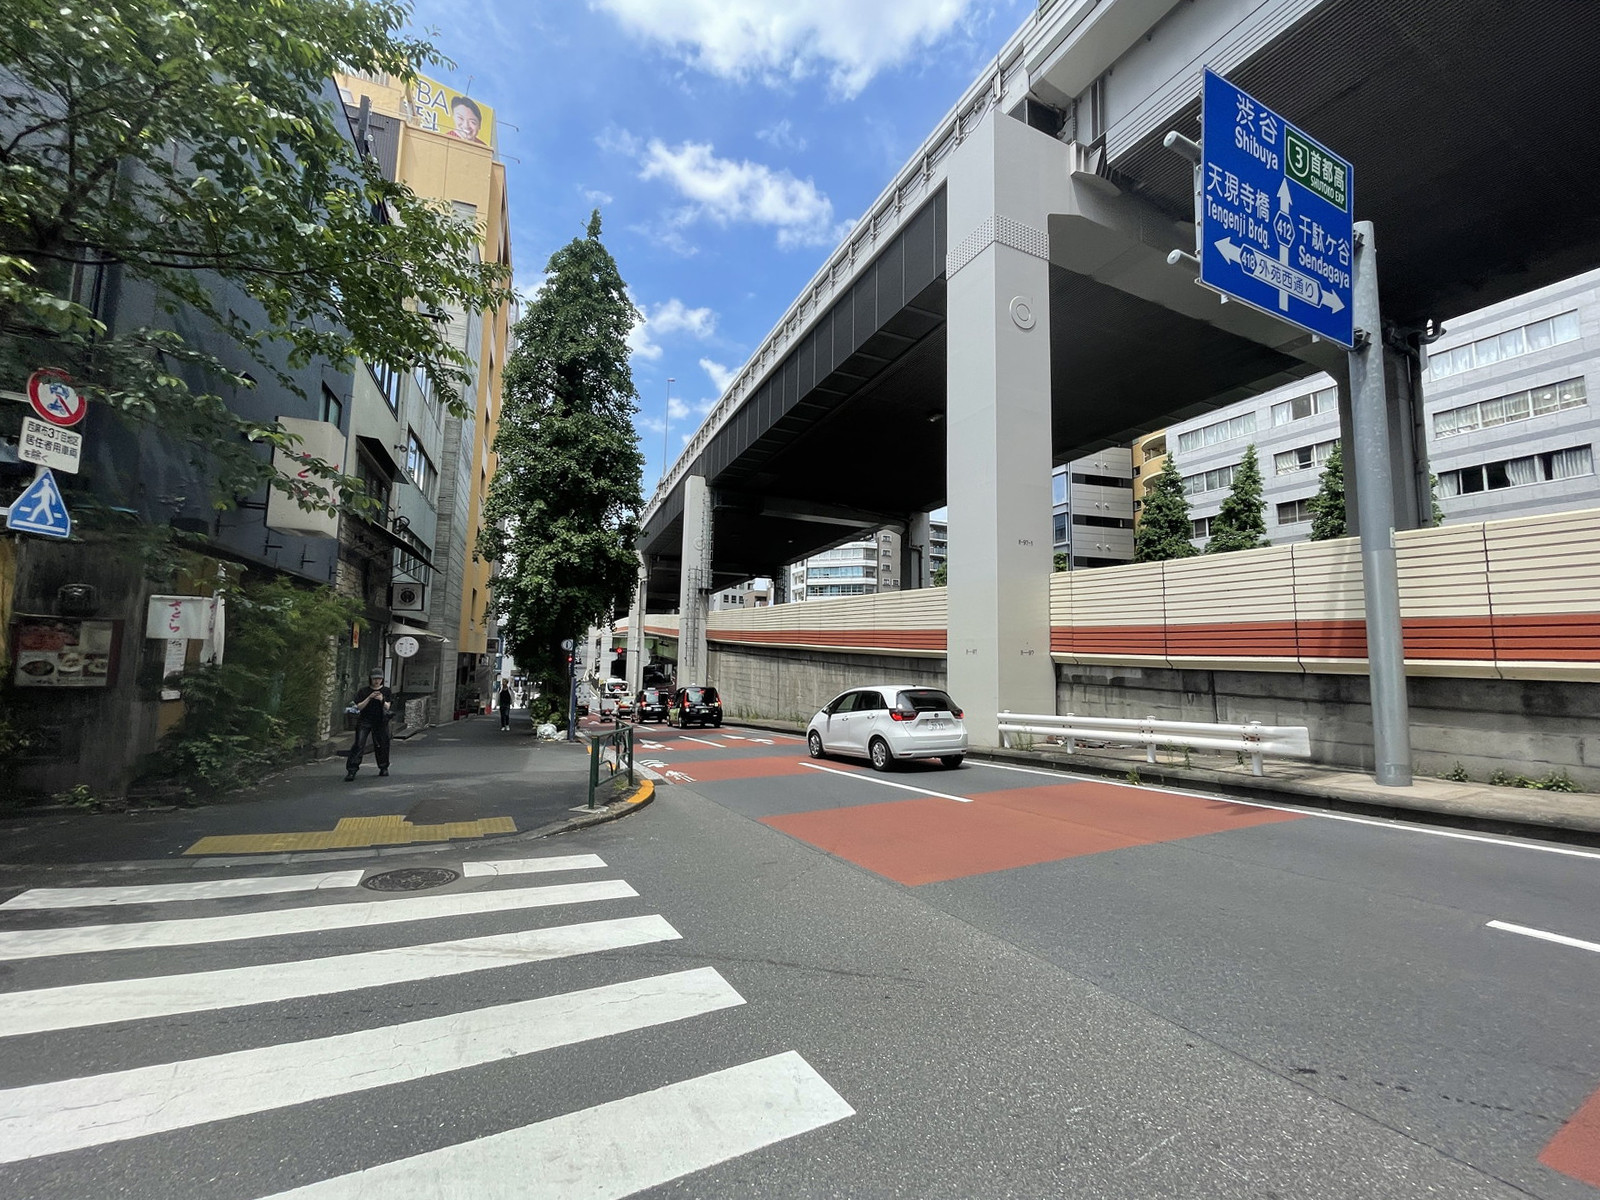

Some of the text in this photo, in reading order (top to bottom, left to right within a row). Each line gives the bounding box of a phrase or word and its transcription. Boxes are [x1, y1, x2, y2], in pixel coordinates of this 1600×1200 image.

[1236, 94, 1278, 145] 渋谷
[1235, 126, 1279, 170] Shibuya
[1295, 146, 1303, 169] 3
[1207, 161, 1270, 223] 天現寺橋
[1310, 150, 1345, 192] 首都高
[1310, 175, 1345, 205] SHUTOKO EXP
[1206, 194, 1270, 250] Tengenji Brdg.
[1276, 219, 1292, 241] 412
[1299, 214, 1350, 267] 千駄ヶ谷
[1241, 251, 1256, 271] 418
[1258, 258, 1315, 300] 外苑西通り
[1298, 244, 1350, 289] Sendagaya
